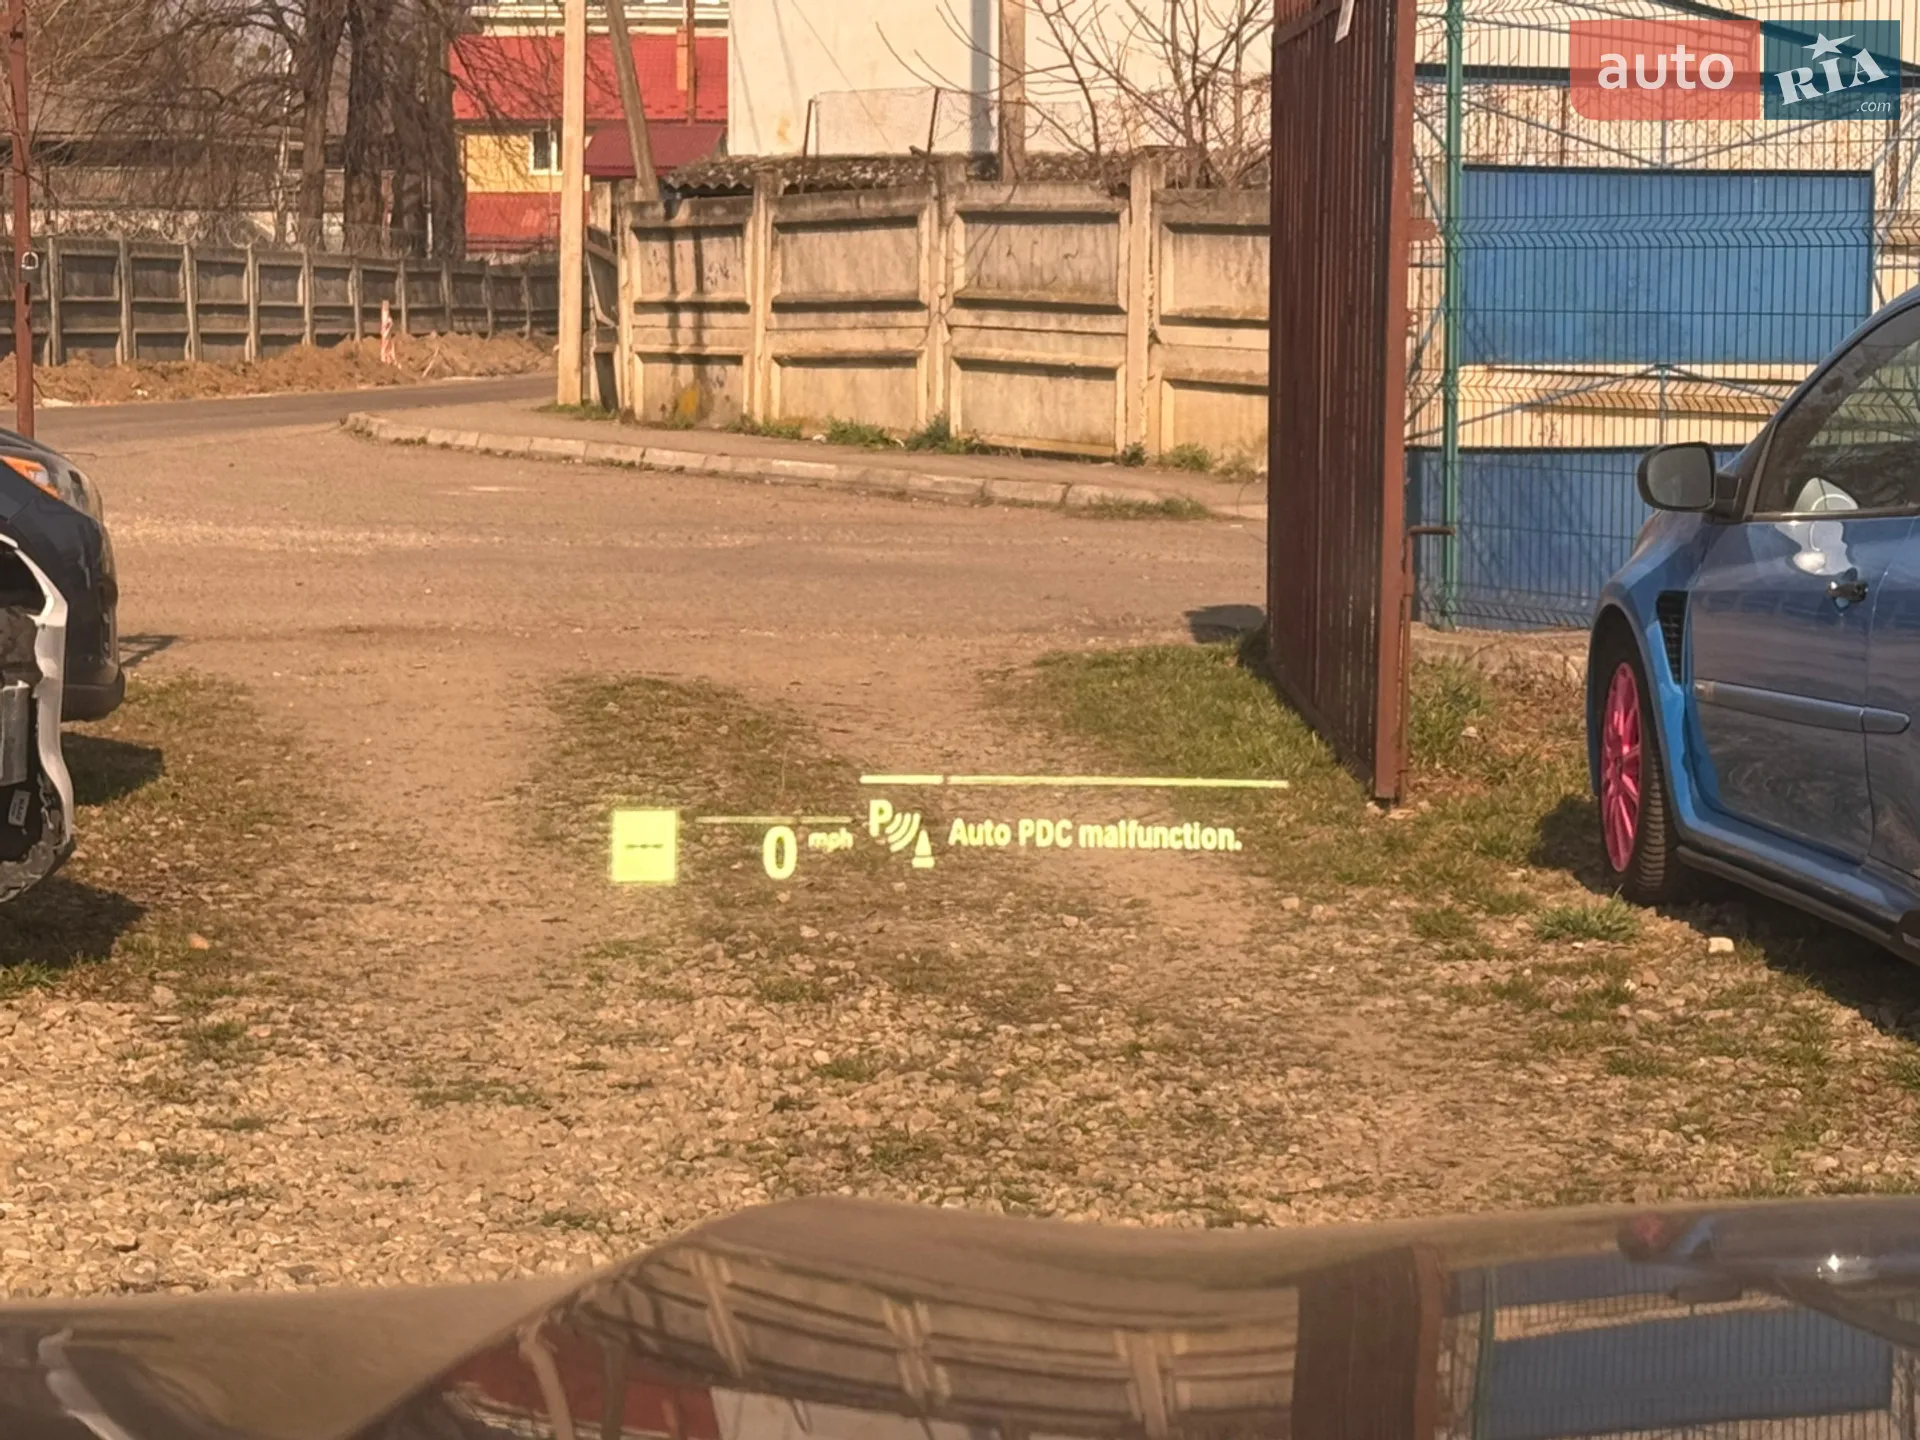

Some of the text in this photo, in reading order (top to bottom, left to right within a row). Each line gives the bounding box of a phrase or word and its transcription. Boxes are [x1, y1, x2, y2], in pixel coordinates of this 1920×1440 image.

[762, 825, 854, 880] 0 mph
[948, 817, 1243, 851] Auto PDC malfunction.
